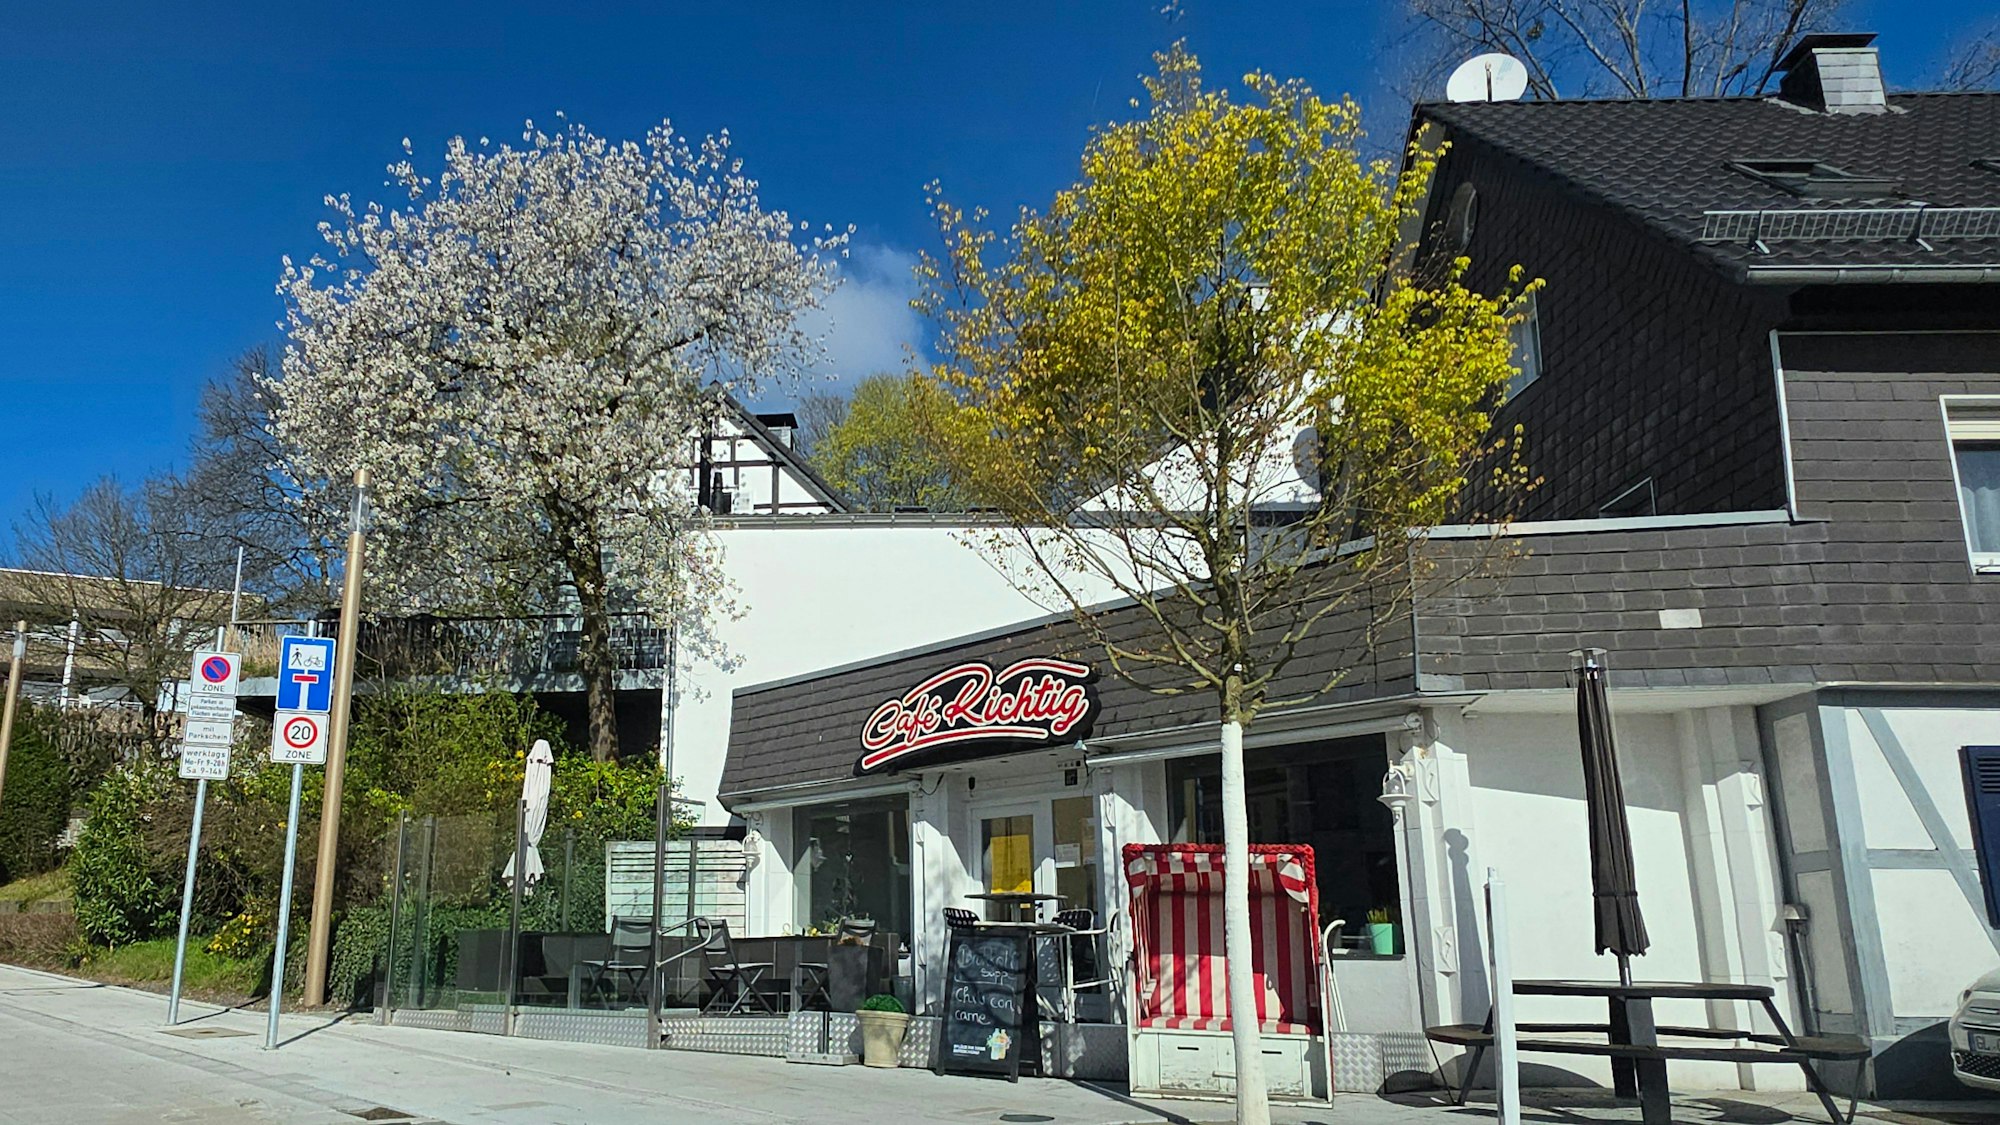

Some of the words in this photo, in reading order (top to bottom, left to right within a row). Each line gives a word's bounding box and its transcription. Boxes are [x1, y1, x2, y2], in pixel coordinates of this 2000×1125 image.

[202, 684, 225, 692] ZONE
[862, 696, 942, 748] Café
[902, 660, 1089, 736] Richtig
[188, 732, 228, 740] Parkschein
[291, 725, 311, 740] 20
[186, 750, 226, 759] werktags
[285, 750, 312, 760] ZONE
[186, 766, 197, 774] Sa
[990, 997, 1015, 1012] con
